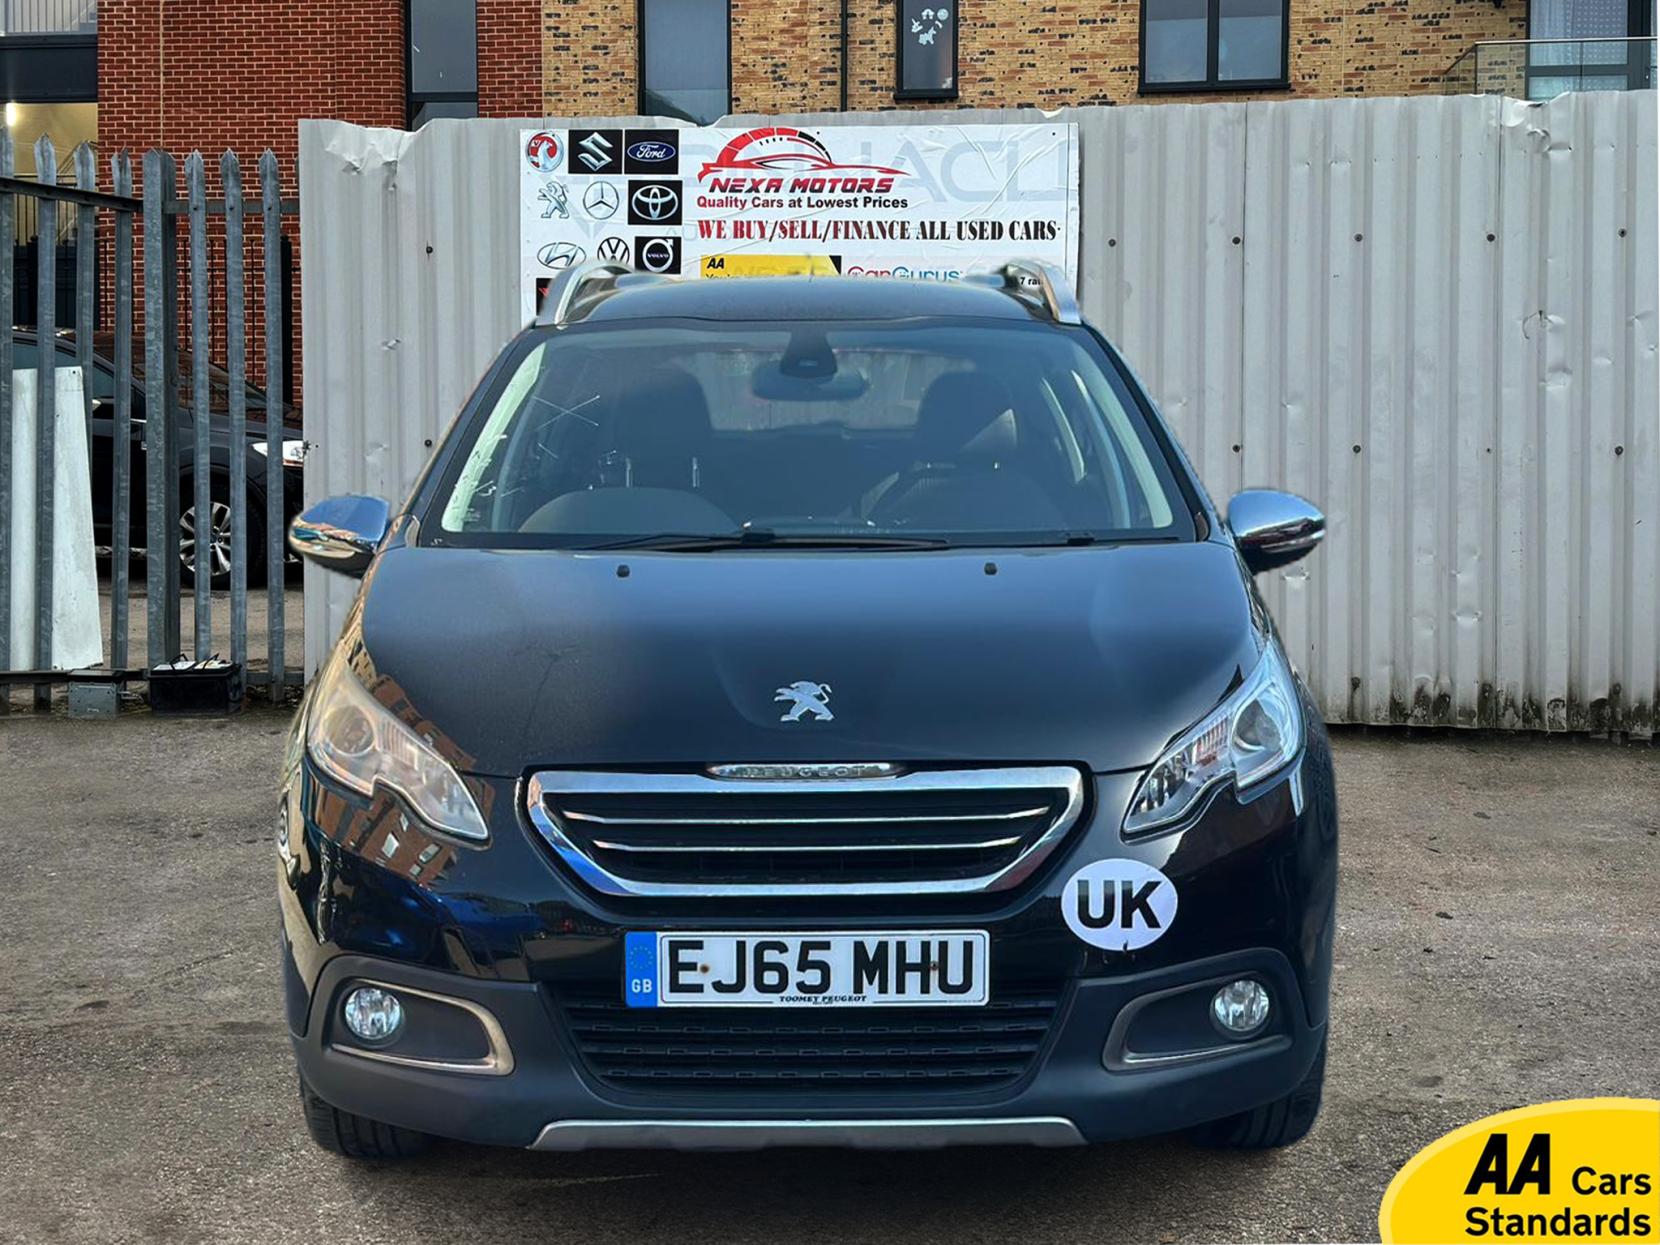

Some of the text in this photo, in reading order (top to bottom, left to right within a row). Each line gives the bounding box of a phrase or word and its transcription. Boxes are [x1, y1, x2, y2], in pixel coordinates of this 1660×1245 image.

[636, 144, 666, 159] Ford
[709, 178, 894, 193] NEXA MOTORS
[697, 196, 908, 211] Quality Cars at Lowest Prices
[697, 220, 727, 240] WE
[916, 220, 950, 240] ALL
[956, 220, 1004, 240] USED
[1009, 220, 1057, 240] CARS
[707, 257, 725, 269] AA
[1076, 879, 1162, 930] UK
[668, 940, 974, 994] EJ65 MHU
[631, 978, 653, 994] GB
